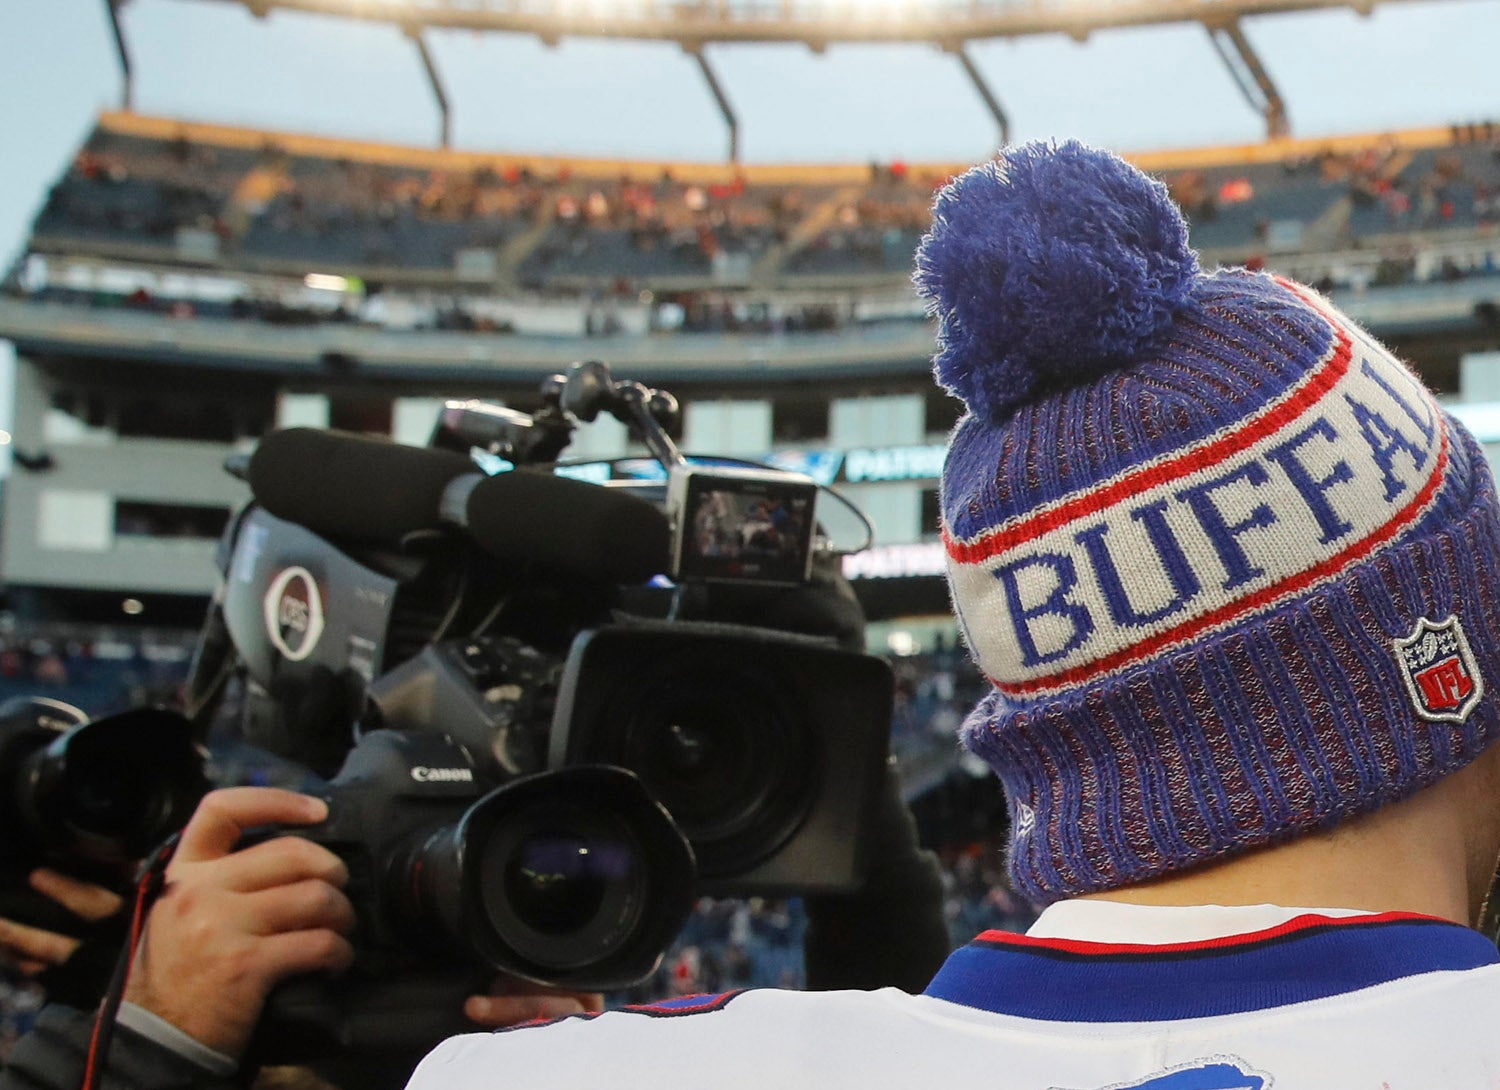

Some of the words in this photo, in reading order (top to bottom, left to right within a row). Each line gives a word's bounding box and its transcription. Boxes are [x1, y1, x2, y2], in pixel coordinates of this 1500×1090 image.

[991, 352, 1436, 671] BUFFAL
[1415, 657, 1473, 711] NFL
[409, 765, 474, 782] Canon
